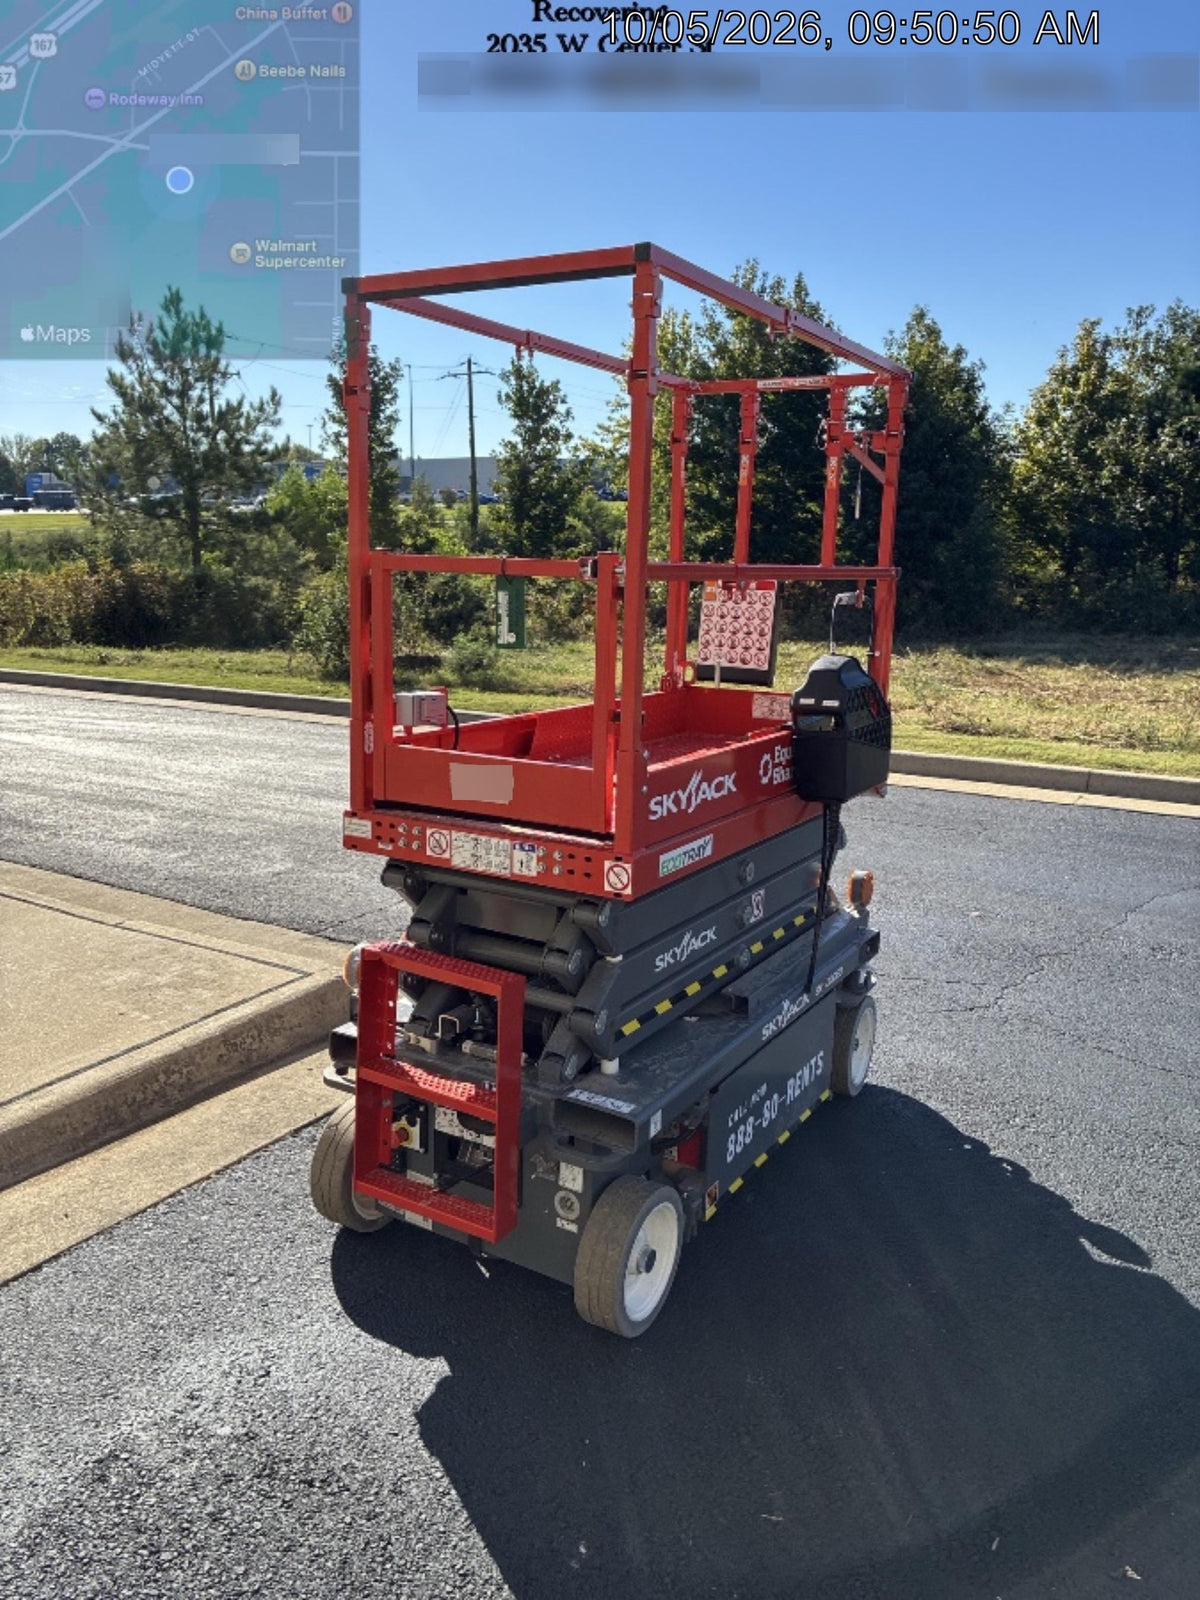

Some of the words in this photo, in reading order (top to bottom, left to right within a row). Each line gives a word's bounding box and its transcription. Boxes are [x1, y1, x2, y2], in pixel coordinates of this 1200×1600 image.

[648, 768, 738, 821] SKYJACK
[654, 925, 718, 972] SKYJACK
[762, 993, 810, 1041] SKYJACK
[726, 1050, 825, 1164] 888-80-RENTS
